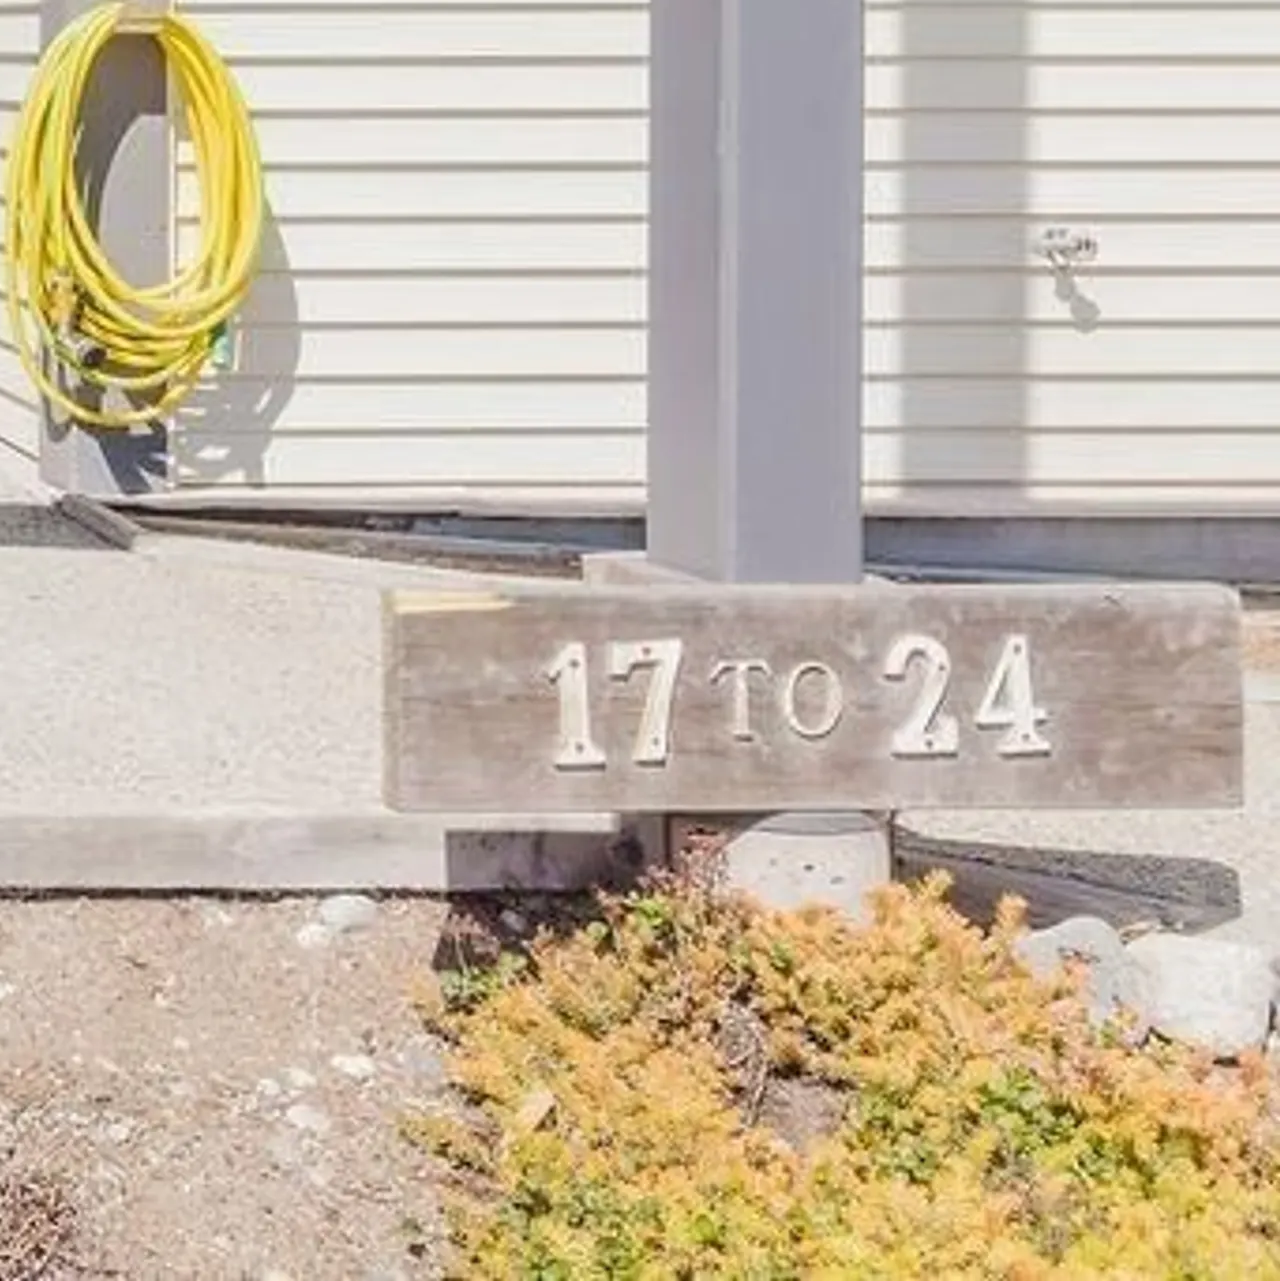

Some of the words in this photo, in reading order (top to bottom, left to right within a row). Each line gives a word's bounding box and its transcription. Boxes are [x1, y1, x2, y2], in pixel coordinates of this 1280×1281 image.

[544, 637, 683, 769] 17
[709, 660, 843, 741] TO
[881, 633, 1053, 757] 24
